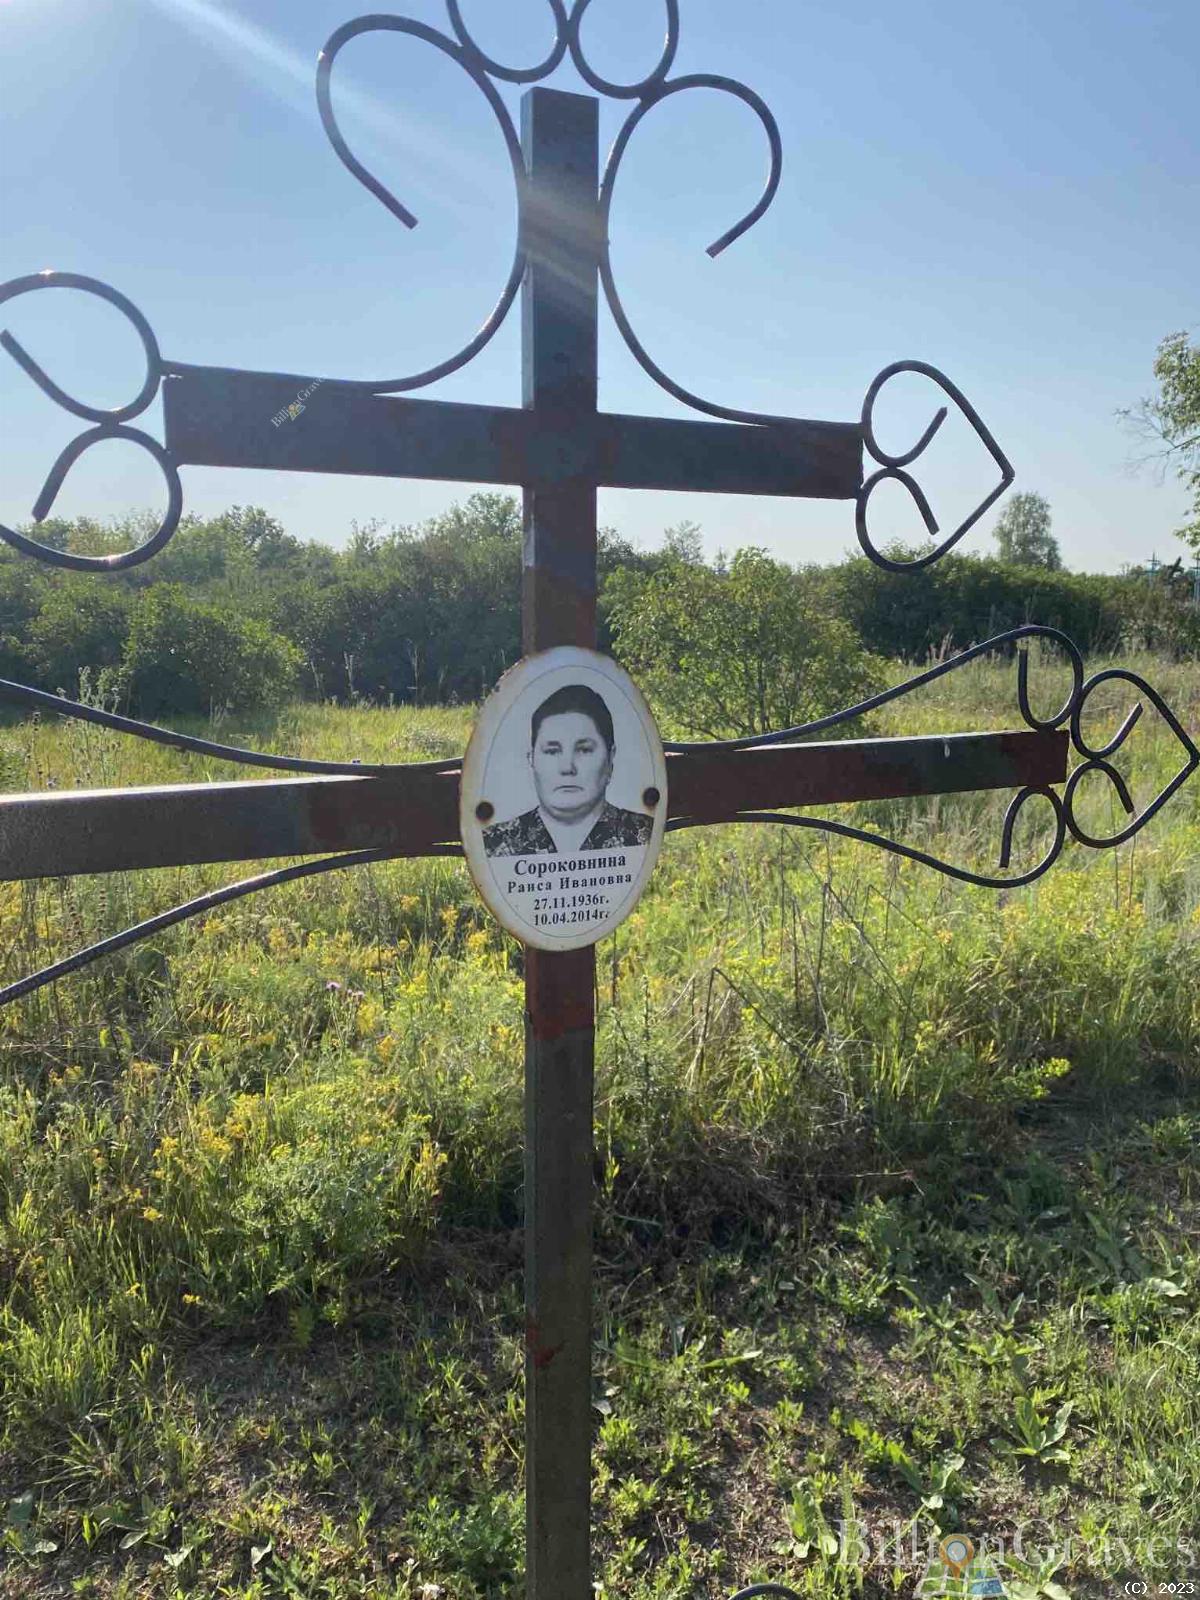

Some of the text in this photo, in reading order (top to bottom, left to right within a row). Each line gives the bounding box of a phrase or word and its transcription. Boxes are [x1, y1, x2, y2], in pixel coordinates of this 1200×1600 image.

[514, 855, 626, 878] Сороковнина
[508, 874, 632, 894] Раиса Ивановна
[534, 893, 609, 910] 27.11.1936г.
[534, 909, 609, 926] 10.04.2014г.
